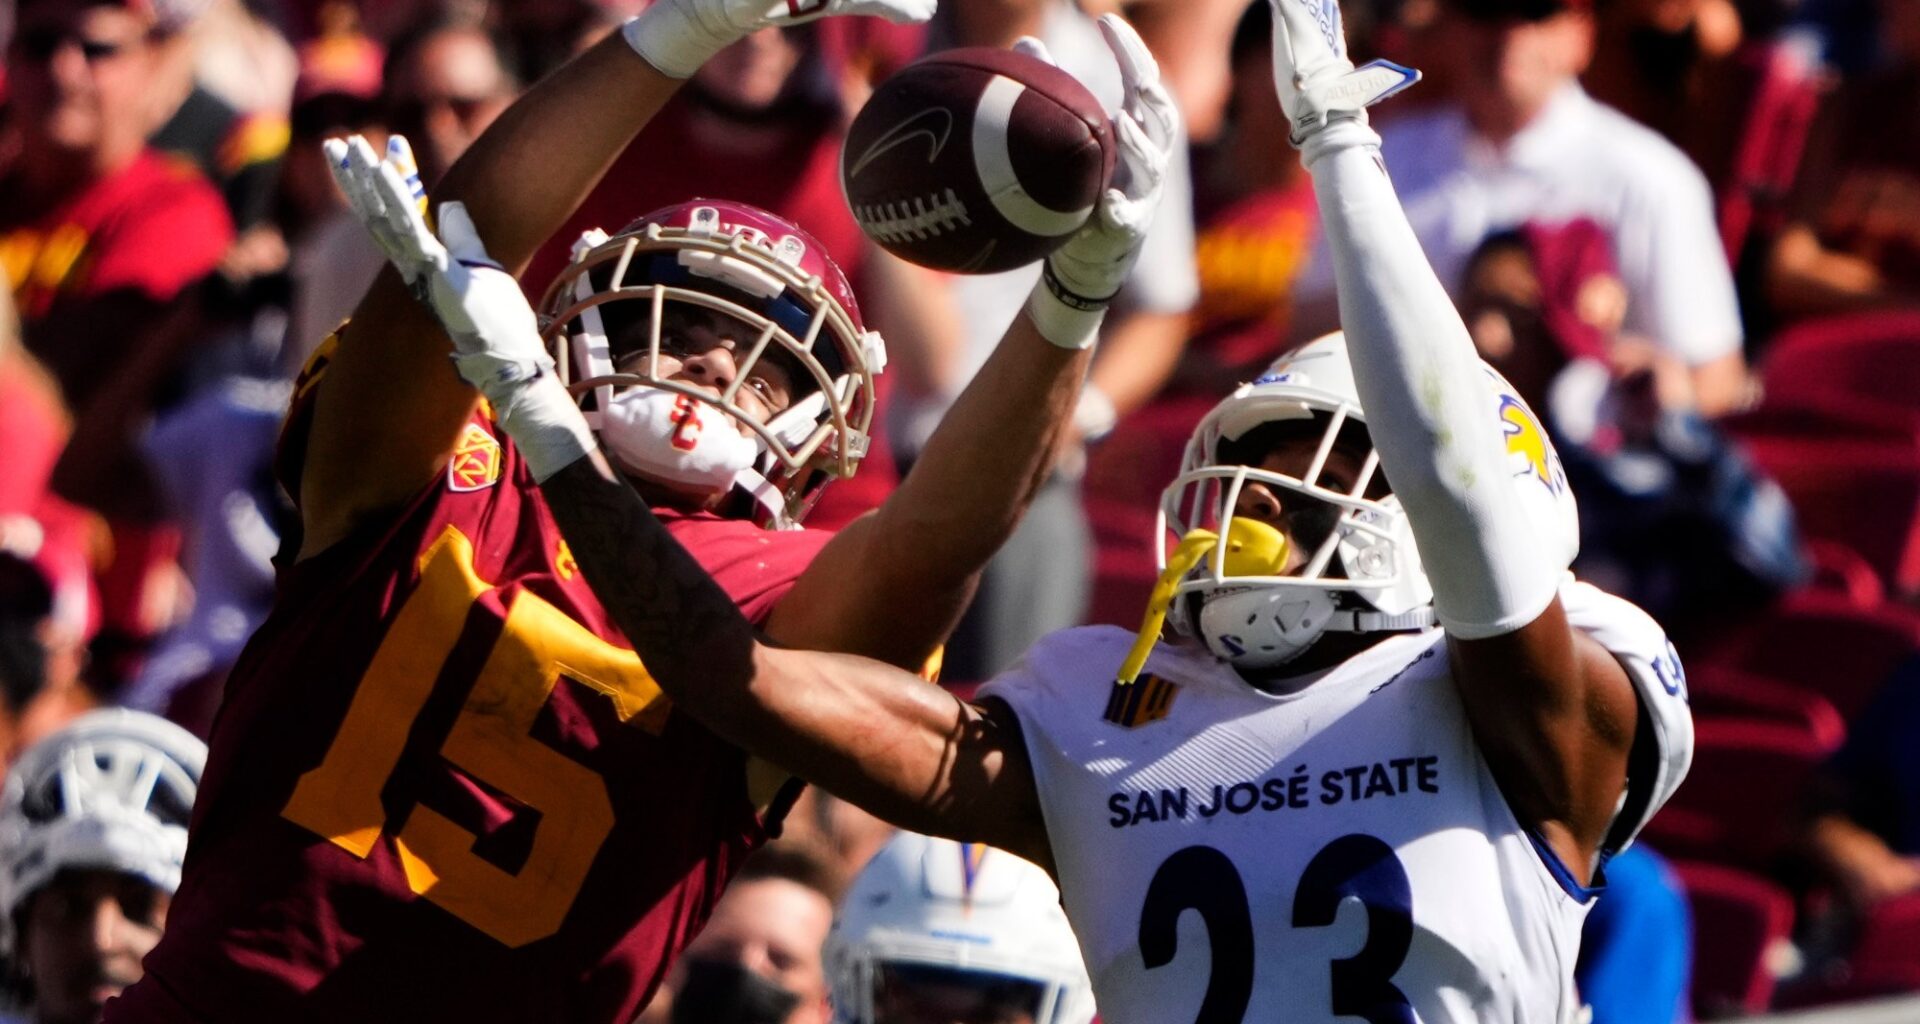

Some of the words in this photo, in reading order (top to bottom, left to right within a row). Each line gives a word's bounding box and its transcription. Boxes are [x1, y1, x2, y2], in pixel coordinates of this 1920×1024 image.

[279, 524, 673, 949] 15
[1108, 787, 1187, 828] SAN
[1199, 764, 1310, 818] JOSÉ
[1320, 755, 1439, 805] STATE
[1138, 833, 1416, 1024] 23
